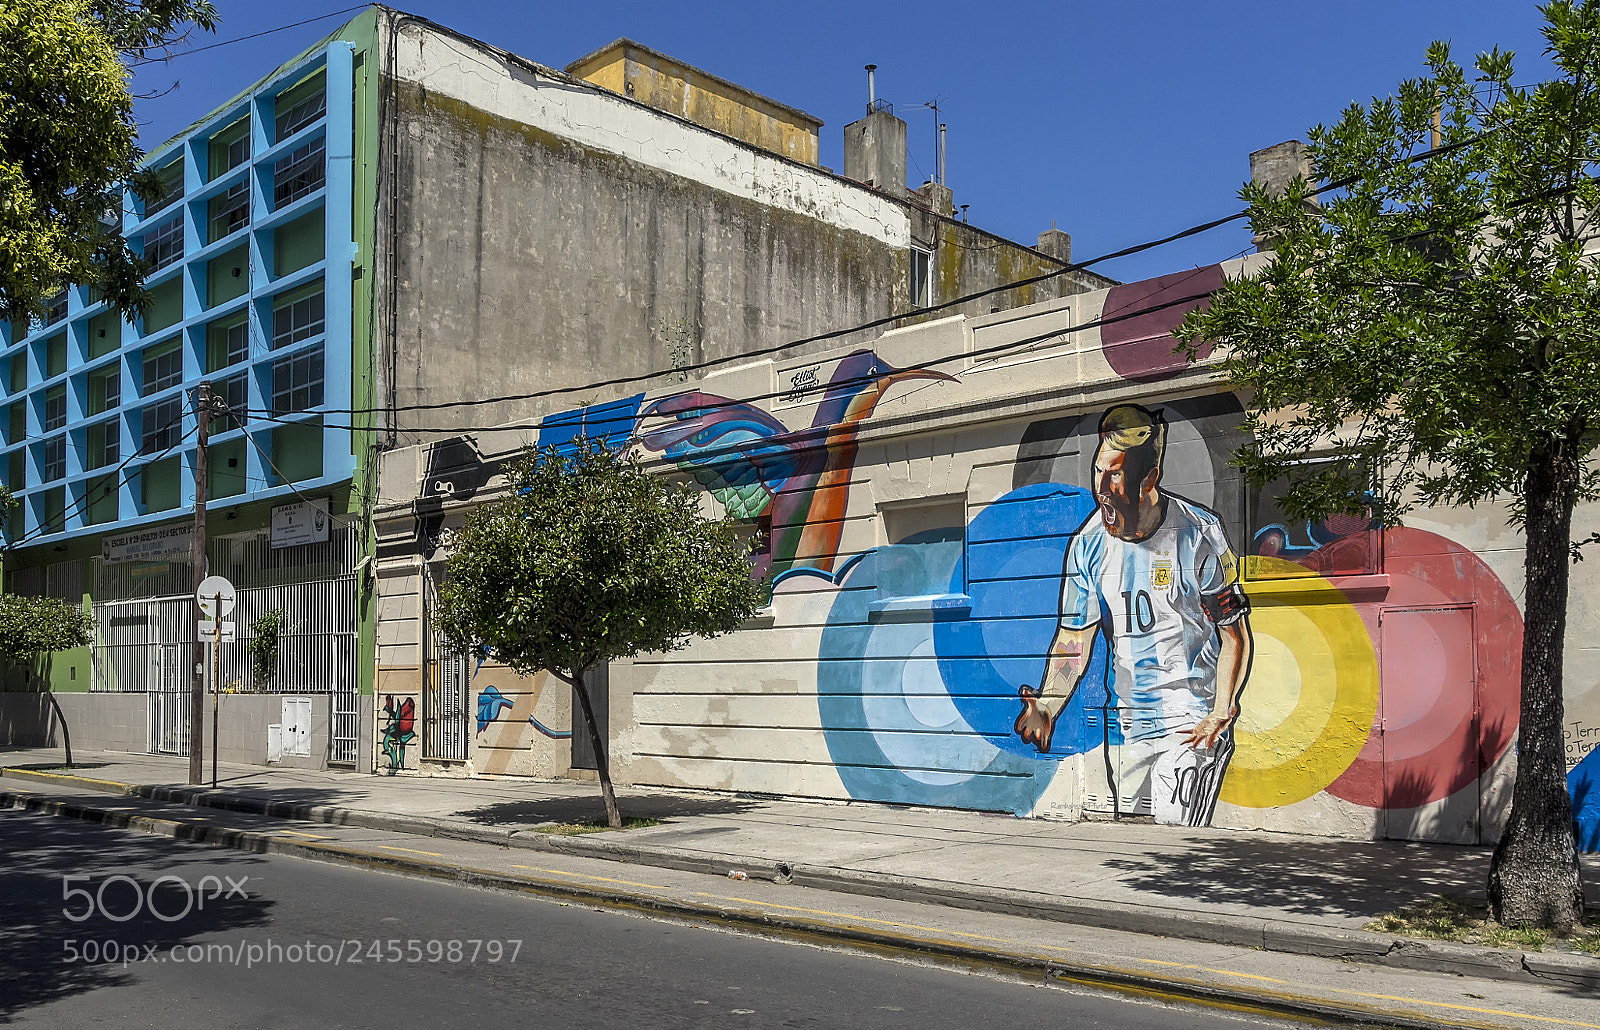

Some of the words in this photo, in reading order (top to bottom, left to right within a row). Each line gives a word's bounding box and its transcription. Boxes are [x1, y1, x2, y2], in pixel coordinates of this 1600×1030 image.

[169, 526, 186, 537] SECTOR
[1121, 589, 1156, 633] 10
[1170, 766, 1199, 809] 10
